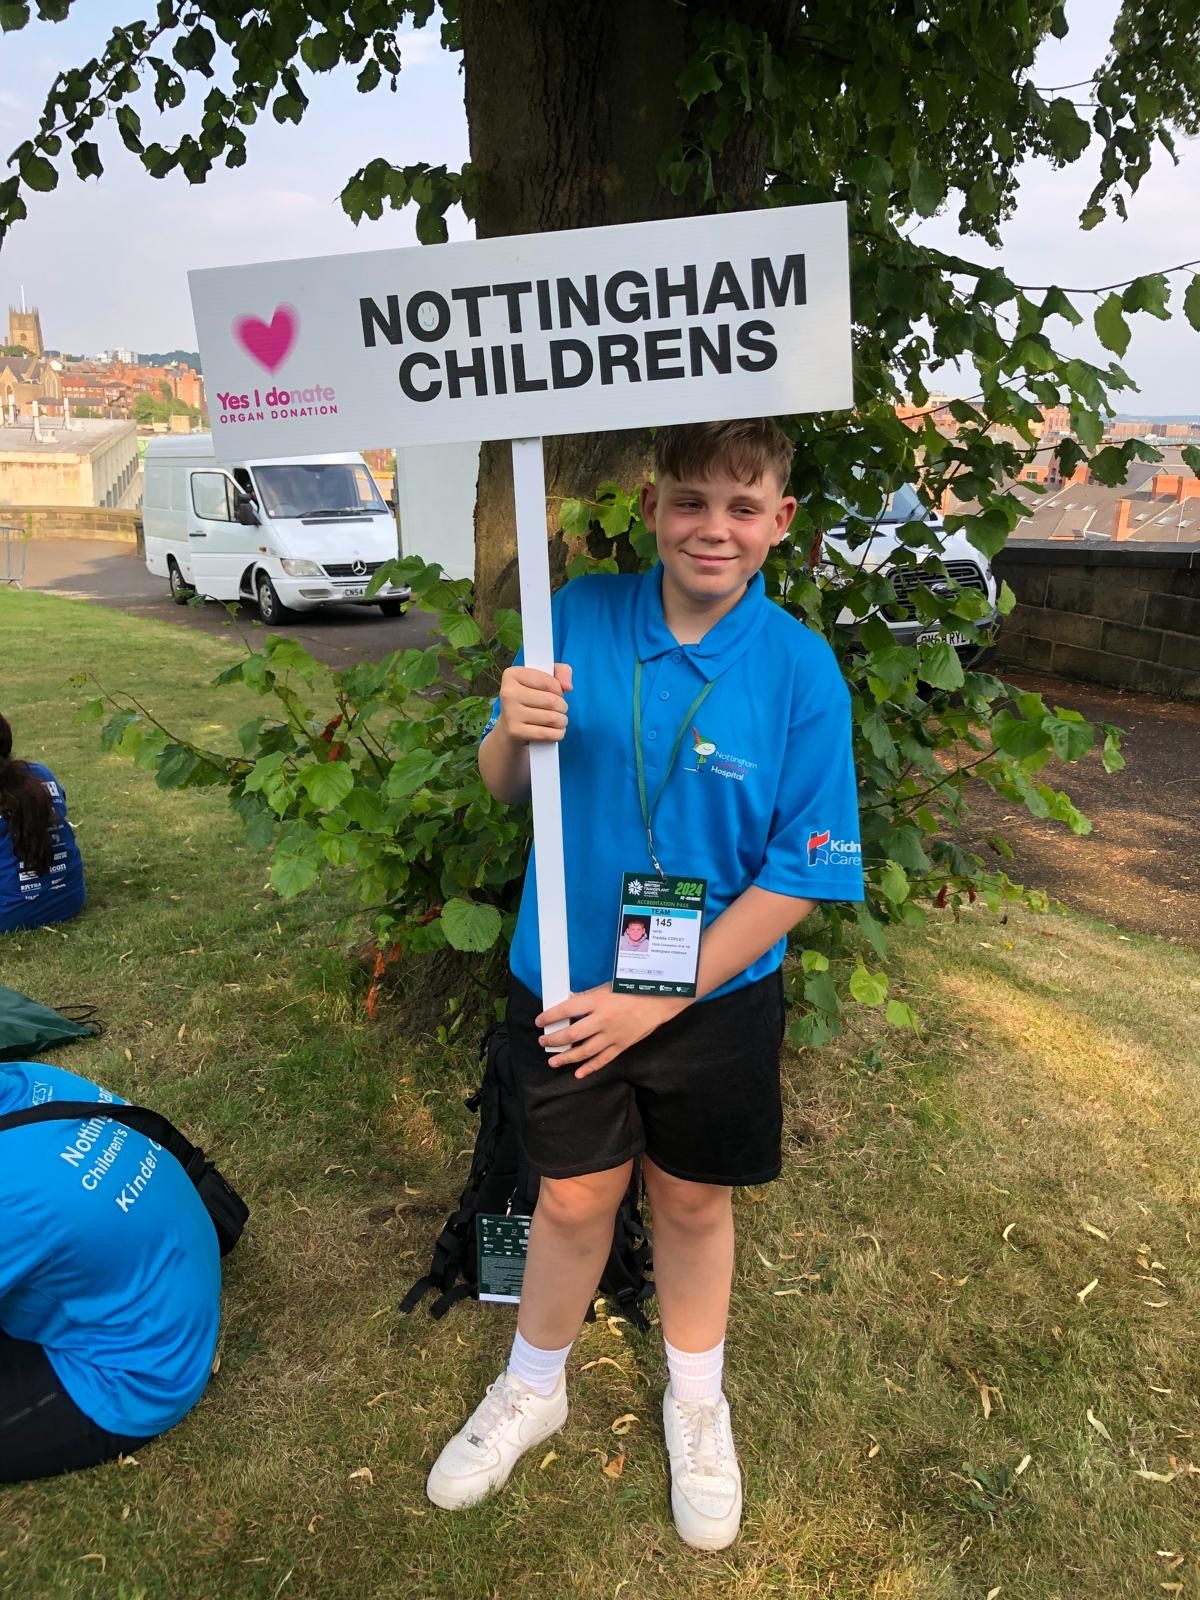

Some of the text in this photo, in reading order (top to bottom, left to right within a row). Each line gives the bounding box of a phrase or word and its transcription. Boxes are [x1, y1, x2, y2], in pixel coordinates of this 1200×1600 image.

[359, 254, 807, 348] NOTTINGHAM
[398, 319, 778, 403] CHILDRENS
[216, 384, 336, 411] Yes I donate
[219, 405, 338, 424] ORGAN DONATION
[715, 750, 758, 770] Nottingham
[710, 765, 745, 781] Hospital
[829, 852, 861, 866] Care
[674, 881, 704, 897] 2024
[651, 908, 671, 916] TEAM
[655, 918, 672, 928] 145
[81, 1128, 129, 1191] Children's
[114, 1150, 159, 1213] Kinder
